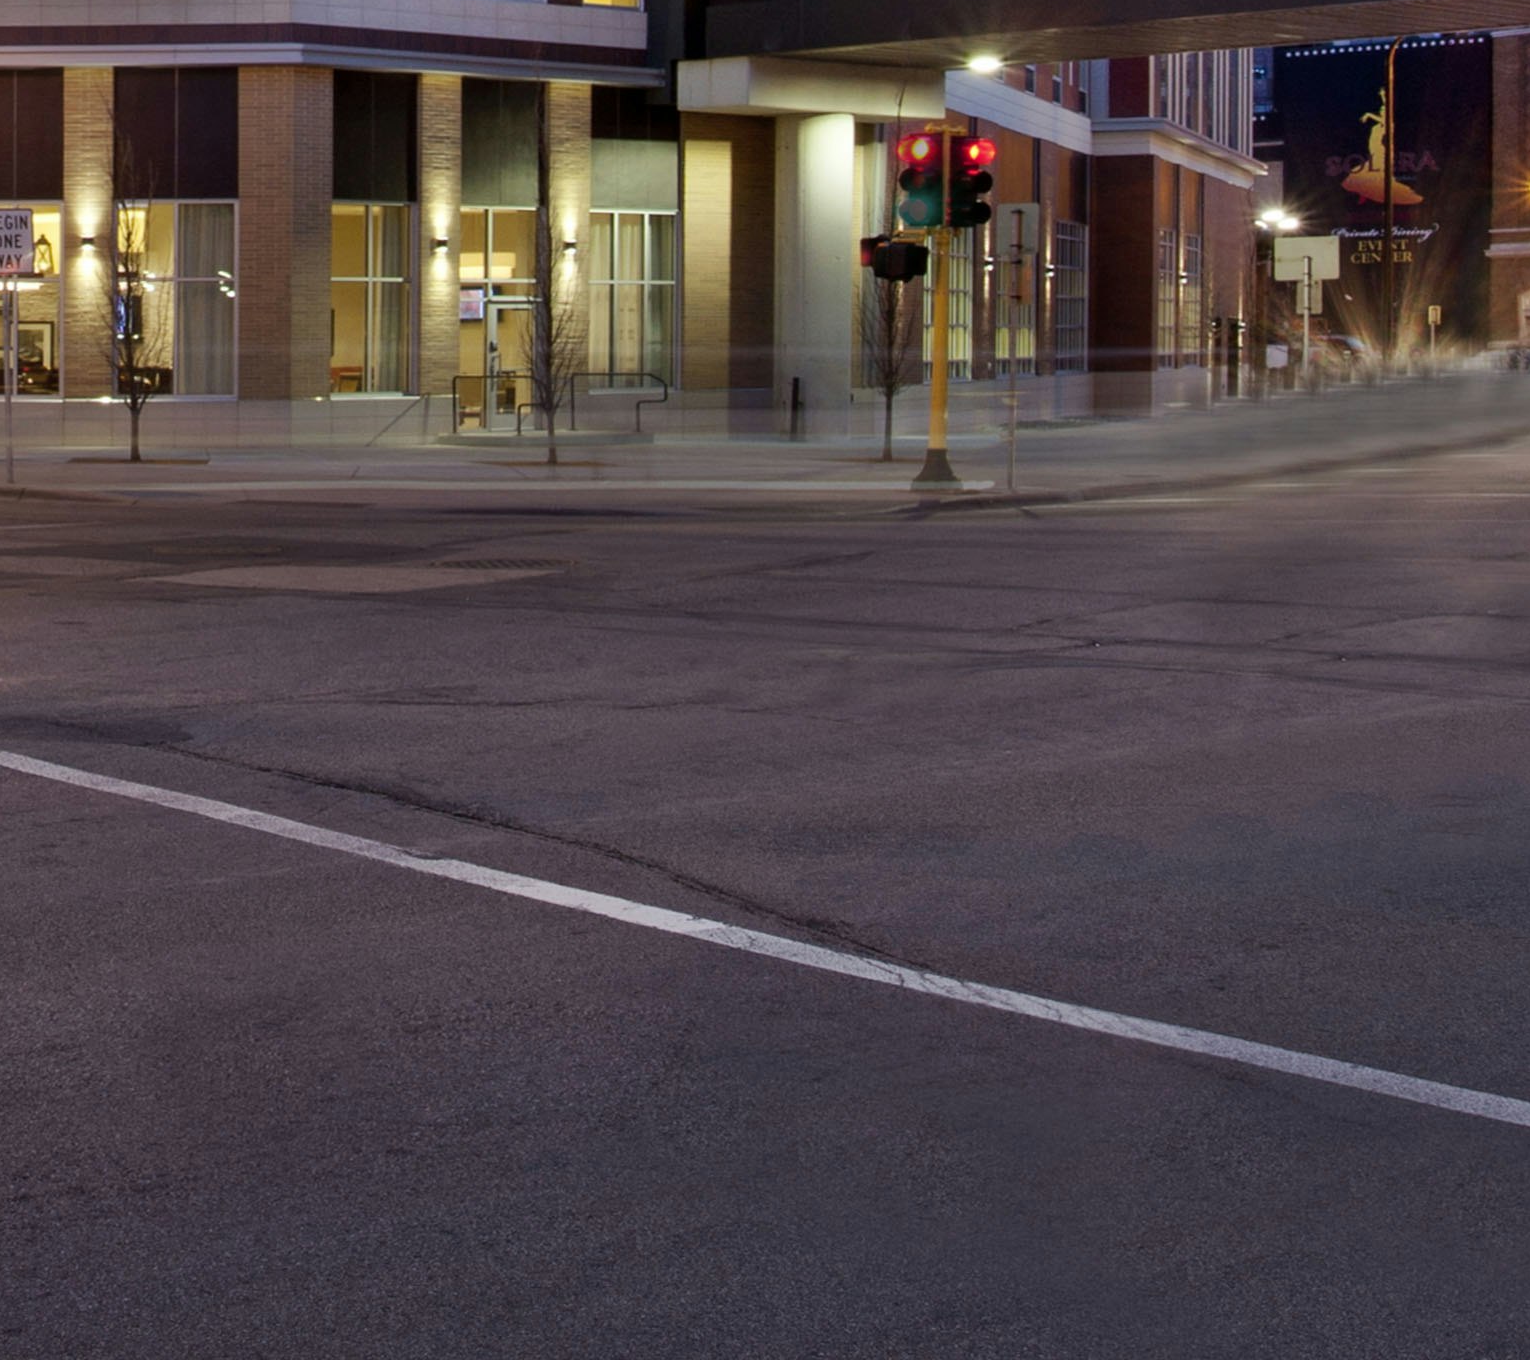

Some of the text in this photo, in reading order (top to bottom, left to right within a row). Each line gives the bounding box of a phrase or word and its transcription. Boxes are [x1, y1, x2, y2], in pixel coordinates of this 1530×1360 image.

[1325, 150, 1439, 177] SOLRA
[1358, 239, 1409, 252] EVNT
[1350, 252, 1413, 264] CENER
